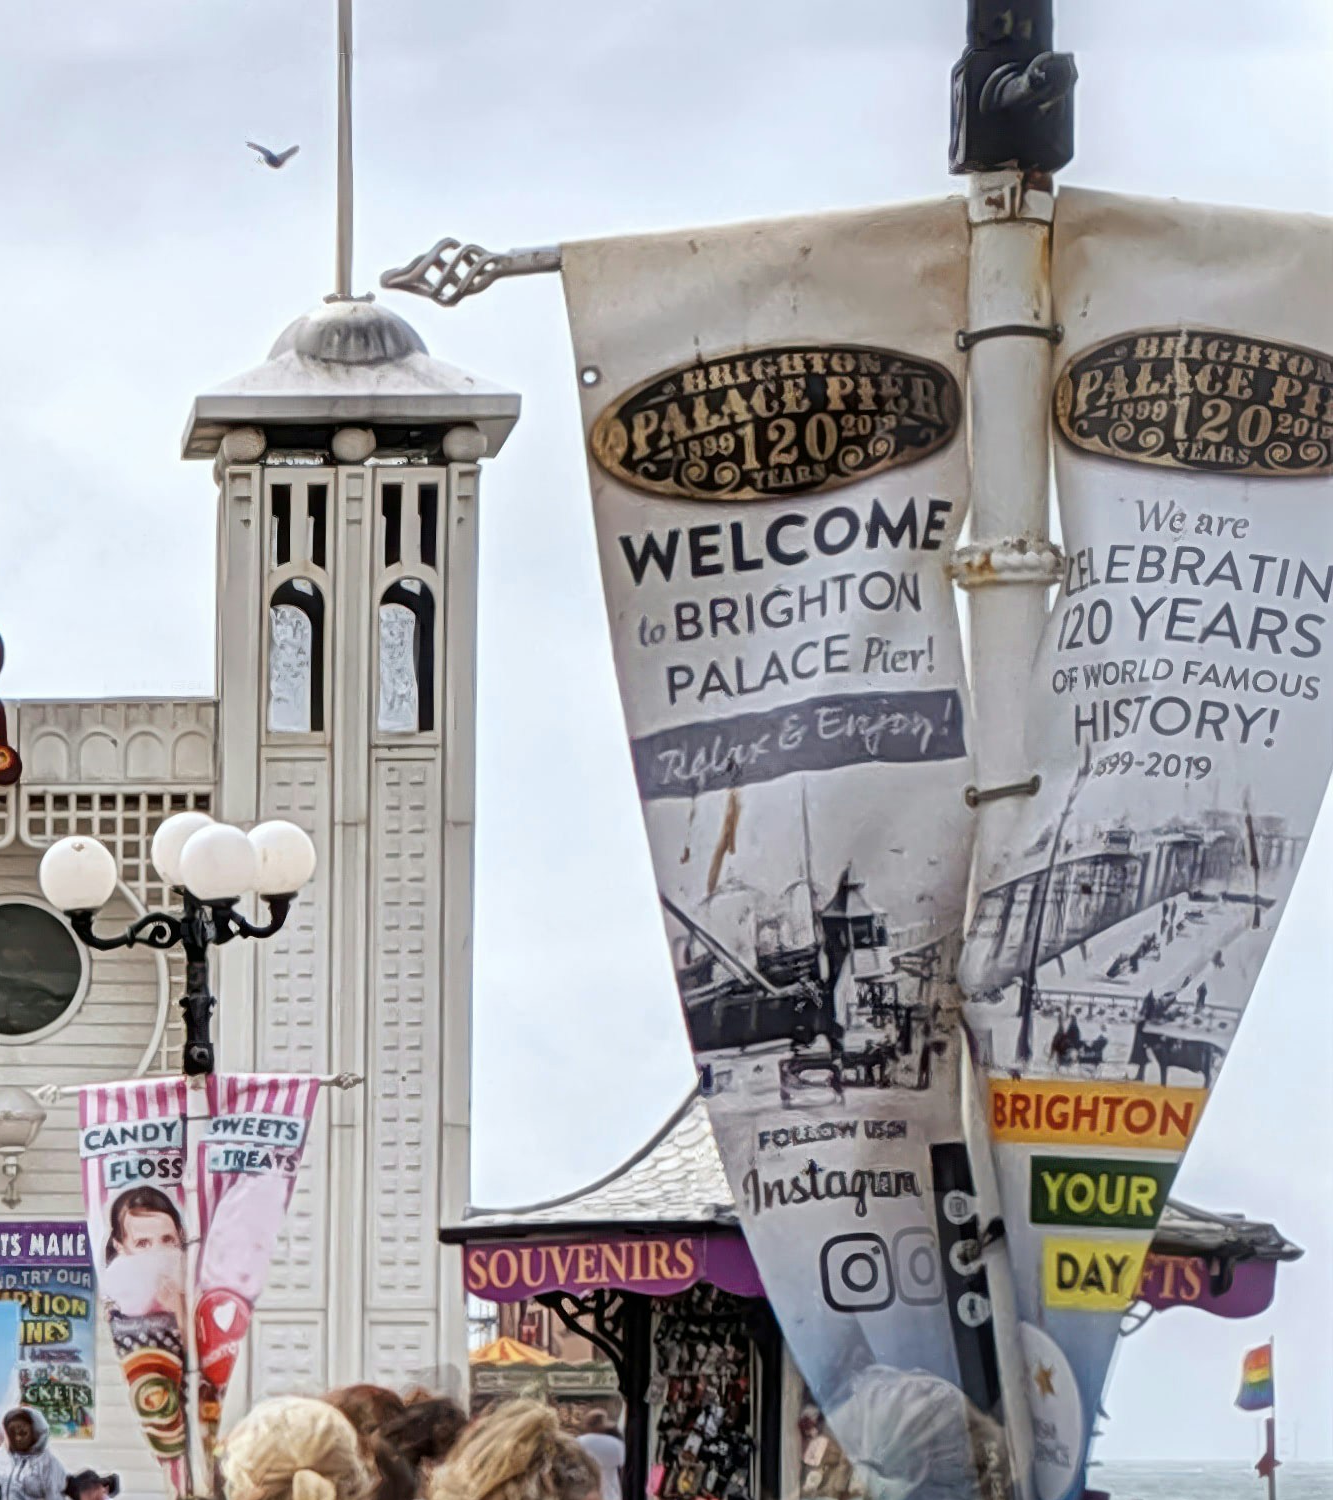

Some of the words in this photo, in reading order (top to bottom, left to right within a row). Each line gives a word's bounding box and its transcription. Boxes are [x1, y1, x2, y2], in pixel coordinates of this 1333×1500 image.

[680, 352, 882, 396] BRIGHTON
[1075, 361, 1255, 417] PALACE
[1268, 375, 1333, 425] PI
[632, 375, 813, 461] PALACE
[825, 374, 943, 424] PIER
[1169, 395, 1273, 448] 120
[735, 412, 839, 471] 120
[1175, 441, 1252, 465] YEARS
[751, 464, 828, 489] YEARS
[1136, 499, 1187, 533] We
[1194, 514, 1250, 540] are
[618, 497, 953, 587] WELCOME
[1064, 544, 1333, 604] CELEBRATIN
[675, 569, 922, 642] BRIGHTON
[1057, 597, 1113, 652] 120
[1130, 595, 1327, 659] YEARS
[666, 632, 851, 706] PALACE
[862, 634, 935, 674] Pier!
[1052, 665, 1079, 695] OF
[1084, 657, 1174, 691] WORLD
[1182, 659, 1321, 701] FAMOUS
[1074, 695, 1281, 749] HISTORY!
[83, 1119, 179, 1152] CANDY
[210, 1116, 300, 1141] SWEETS
[758, 1120, 859, 1151] FOLLOW
[992, 1092, 1195, 1138] BRIGHTON
[108, 1156, 184, 1182] FLOSS
[222, 1148, 298, 1173] TREATS
[1040, 1170, 1159, 1217] YOUR
[28, 1232, 87, 1257] MAKE
[467, 1237, 696, 1291] SOUVENIRS
[20, 1268, 53, 1286] TRY
[56, 1268, 92, 1289] OUR
[1056, 1250, 1132, 1293] DAY
[1135, 1258, 1203, 1302] FTS
[20, 1320, 71, 1344] INES
[24, 1383, 90, 1405] CKETS
